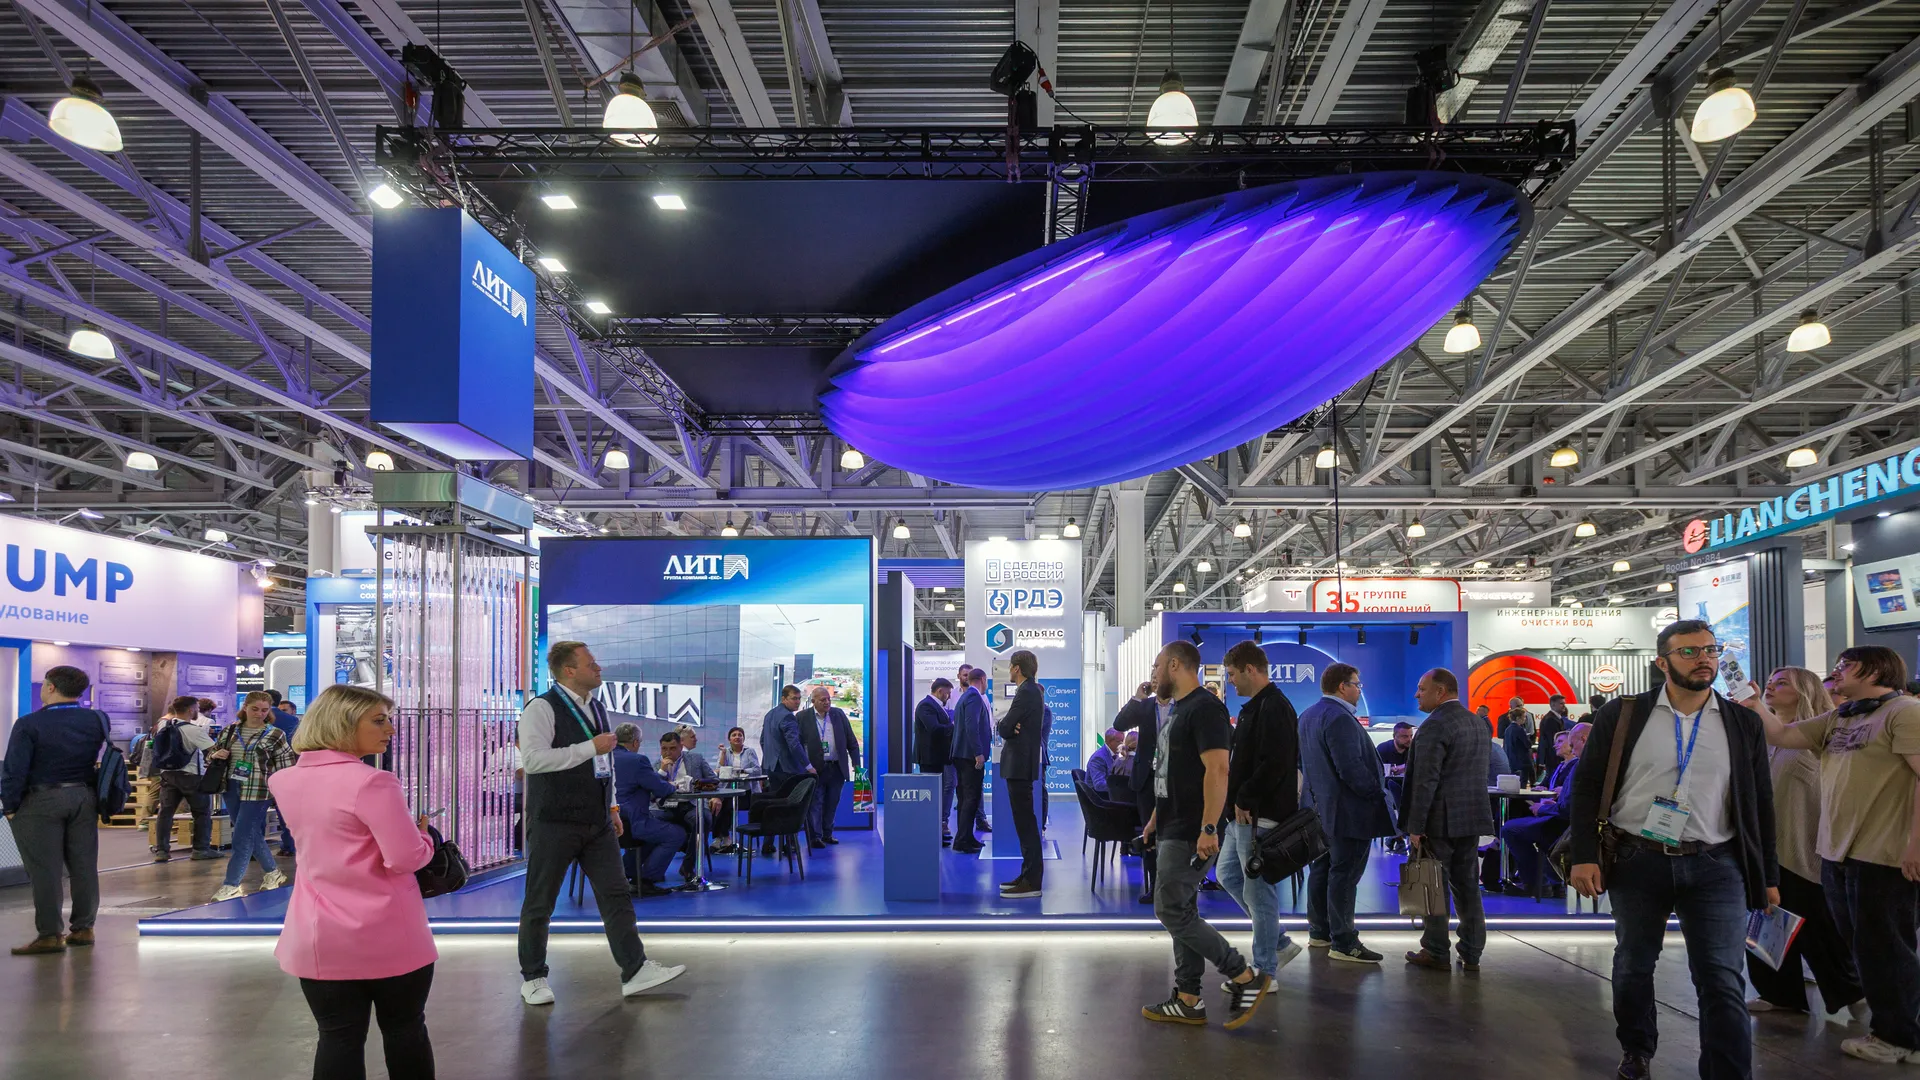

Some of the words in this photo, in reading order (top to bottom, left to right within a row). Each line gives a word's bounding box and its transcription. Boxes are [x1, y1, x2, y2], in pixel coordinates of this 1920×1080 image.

[472, 259, 512, 306] ЛИТ
[663, 555, 723, 575] ЛИТ
[1003, 561, 1064, 570] СДЕЛАНО
[1665, 559, 1689, 574] Booth
[6, 543, 134, 604] UMP
[1013, 570, 1064, 579] РОССИИ
[1014, 589, 1063, 609] РДЭ
[1363, 590, 1407, 599] ГРУППЕ
[1326, 590, 1361, 612] 35
[1363, 603, 1431, 612] КОМПАНИЙ
[1497, 609, 1569, 617] ИНЖЕНЕРНЫЕ
[1572, 609, 1622, 617] РЕШЕНИЯ
[1521, 619, 1569, 627] ОЧИСТКИ
[1572, 619, 1594, 628] ВОД
[1018, 630, 1064, 638] АЛЬЯНС
[1267, 663, 1295, 679] ИТ
[892, 789, 919, 799] ЛИТ
